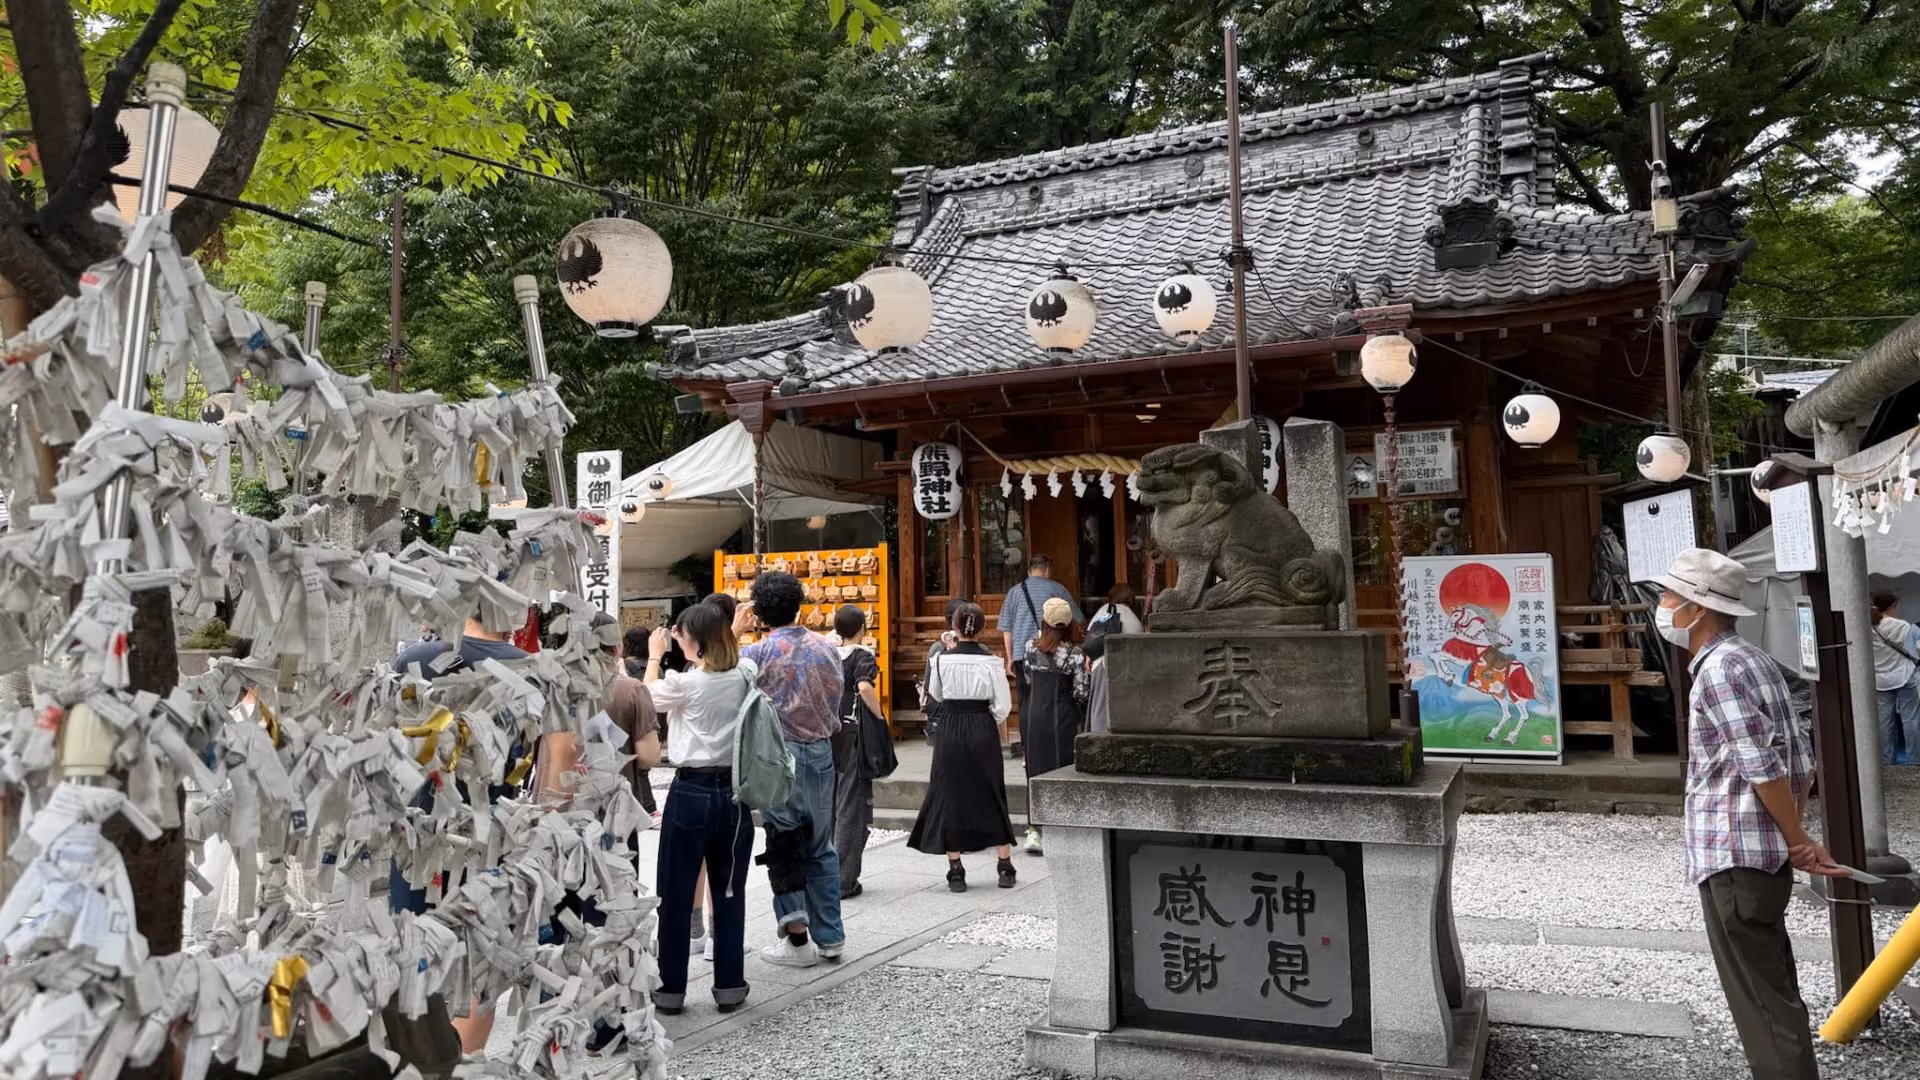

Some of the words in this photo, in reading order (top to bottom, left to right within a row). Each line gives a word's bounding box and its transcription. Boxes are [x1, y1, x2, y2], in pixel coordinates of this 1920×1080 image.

[919, 444, 953, 514] 熊野神社
[1407, 578, 1423, 657] 川越熊野神社
[1518, 600, 1533, 653] 商売繁盛
[1533, 600, 1548, 653] 家内安全
[1183, 639, 1283, 729] 奉
[1152, 862, 1236, 996] 感謝
[1244, 870, 1333, 1008] 神恩
